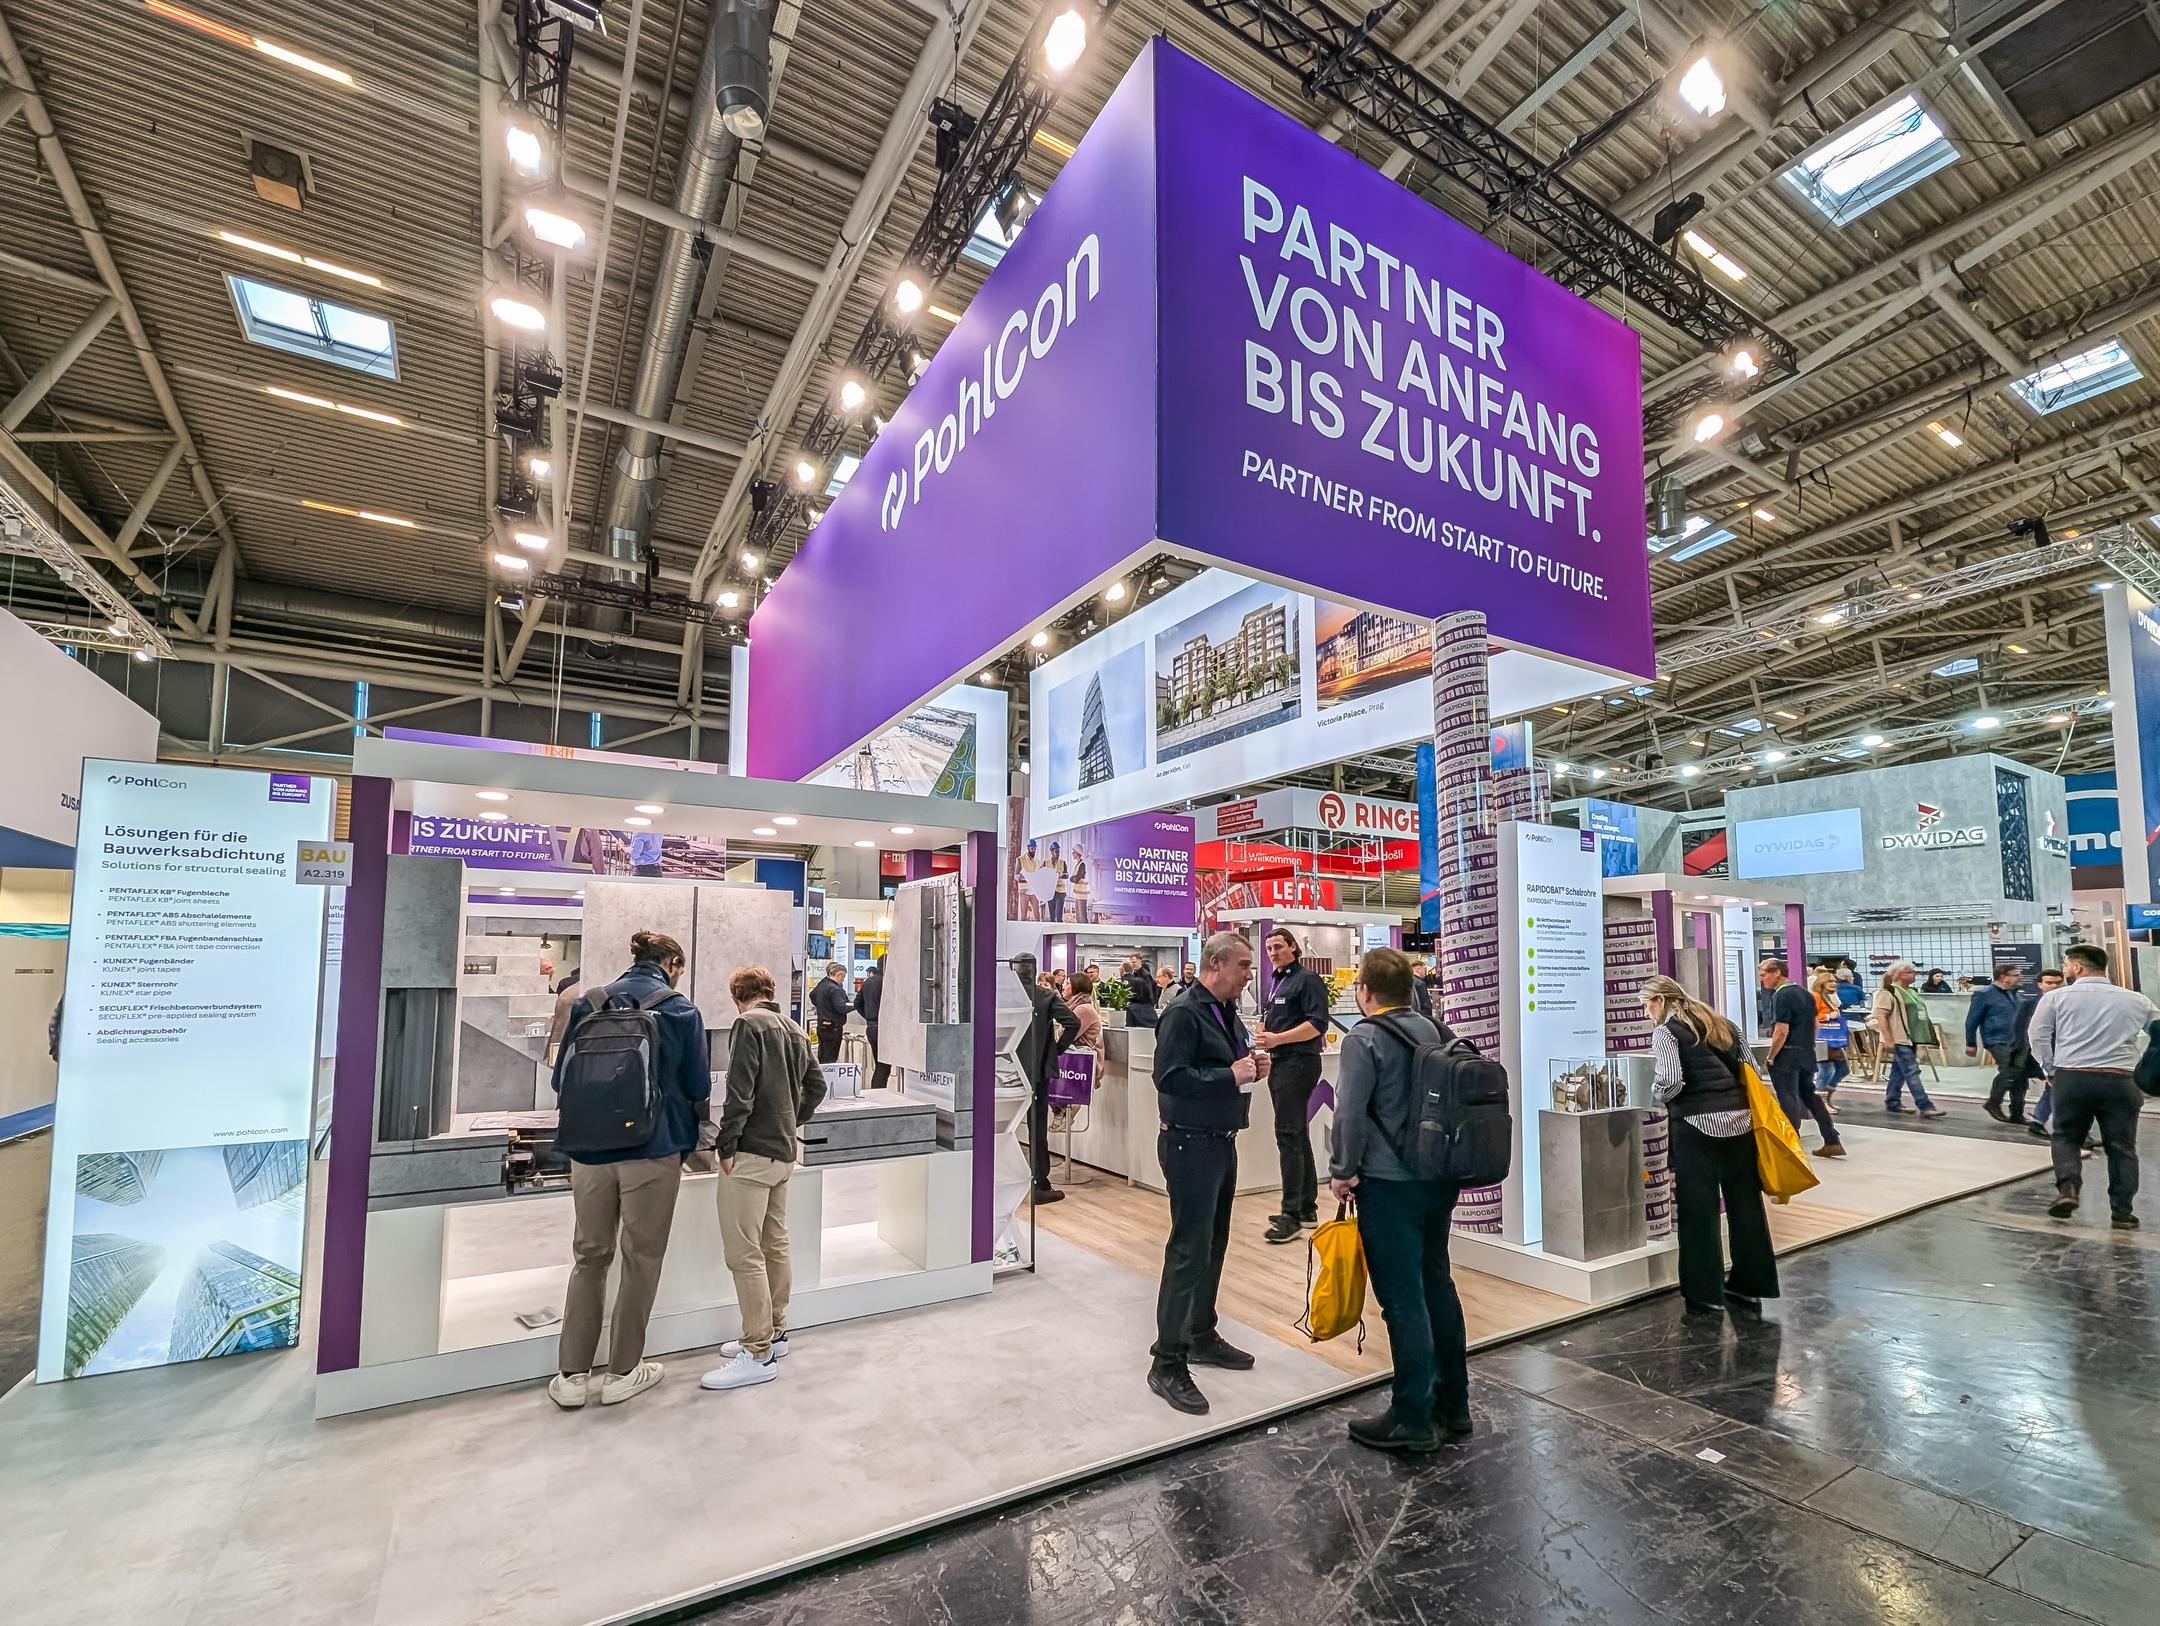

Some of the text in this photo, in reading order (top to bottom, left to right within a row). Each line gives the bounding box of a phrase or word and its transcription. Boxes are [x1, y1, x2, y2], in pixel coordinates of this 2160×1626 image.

[1243, 175, 1507, 371] PARTNER
[913, 233, 1099, 505] PohlCon
[1239, 254, 1600, 477] VON ANFANG
[1245, 339, 1602, 543] BIS ZUKUNFT.
[1242, 450, 1608, 601] PARTNER FROM START TO FUTURE.
[1317, 702, 1384, 728] Victoria Palace, Prag
[125, 776, 187, 789] PohlCon
[105, 825, 247, 843] Lösungen für die
[440, 822, 551, 845] ZUKUNFT.
[1161, 823, 1189, 832] PohlCon
[1754, 838, 1825, 854] DYWIDAG
[1882, 828, 1984, 849] DYWIDAG
[103, 843, 285, 864] Bauwerksabdichtung
[301, 848, 346, 864] BAU
[442, 847, 470, 856] FROM
[471, 849, 500, 857] START
[501, 850, 514, 858] TO
[515, 851, 552, 861] FUTURE.
[1139, 847, 1188, 862] PARTNER
[1248, 852, 1302, 866] Willkommen
[101, 860, 286, 877] Solutions for structural sealing
[304, 869, 345, 878] A2.319
[1114, 858, 1188, 874] VON ANFANG
[1115, 870, 1188, 886] BIS ZUKUNFT.
[108, 895, 156, 903] PENTAFLEX
[109, 887, 158, 895] PENTAFLEX
[177, 889, 230, 897] Fugenbleche
[213, 1127, 288, 1137] www.pohlcon.com
